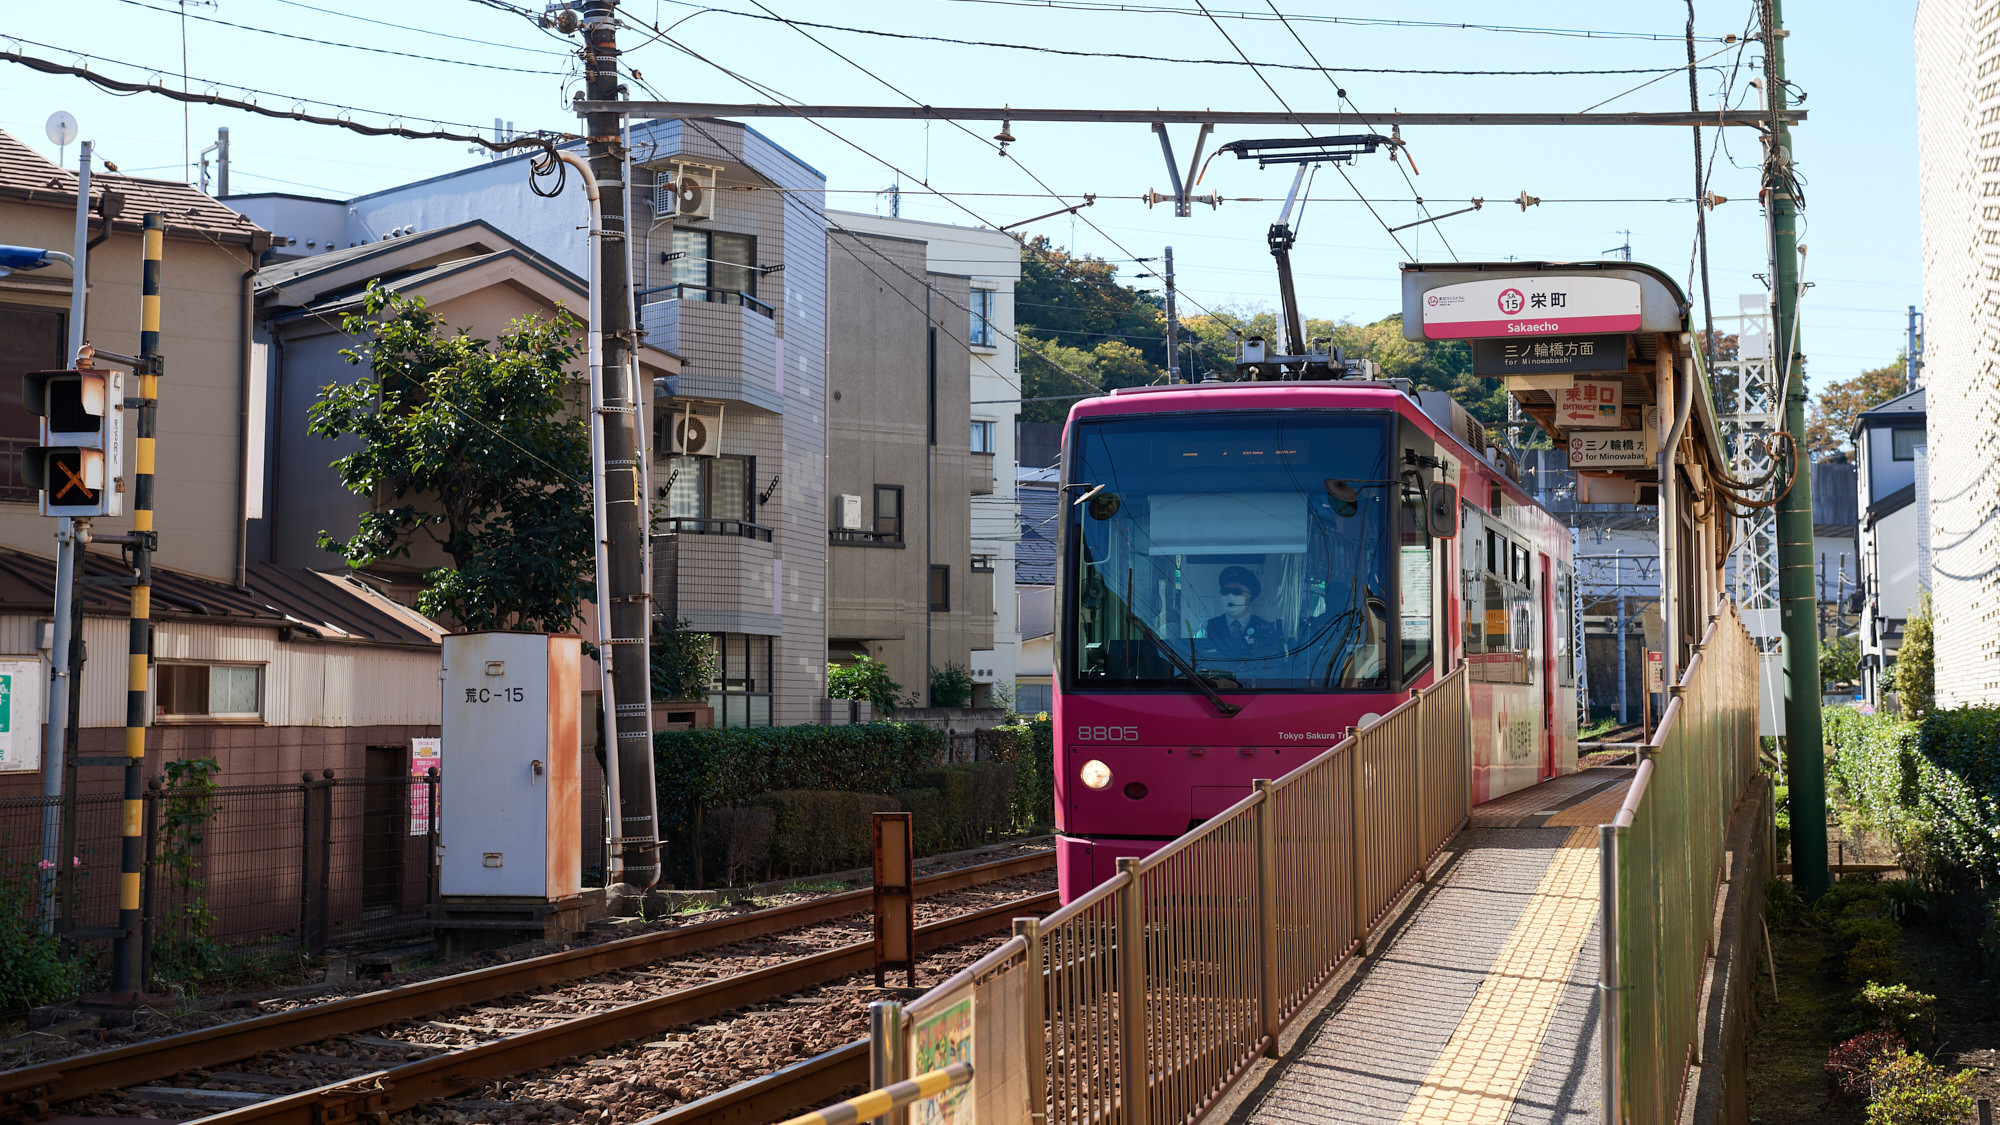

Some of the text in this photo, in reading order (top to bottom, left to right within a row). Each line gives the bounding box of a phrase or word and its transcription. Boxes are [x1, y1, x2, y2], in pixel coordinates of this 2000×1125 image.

[1505, 299, 1519, 309] 15
[1531, 292, 1567, 309] 栄町
[1507, 321, 1559, 333] Sakaecho
[1504, 341, 1595, 358] 三ノ輪橋方面
[1522, 357, 1572, 365] Minowabashi
[1565, 383, 1615, 403] 乗車口
[1585, 453, 1597, 461] for
[1078, 726, 1139, 741] 8805
[1277, 731, 1304, 742] Tokyo
[1305, 731, 1336, 740] Sakura
